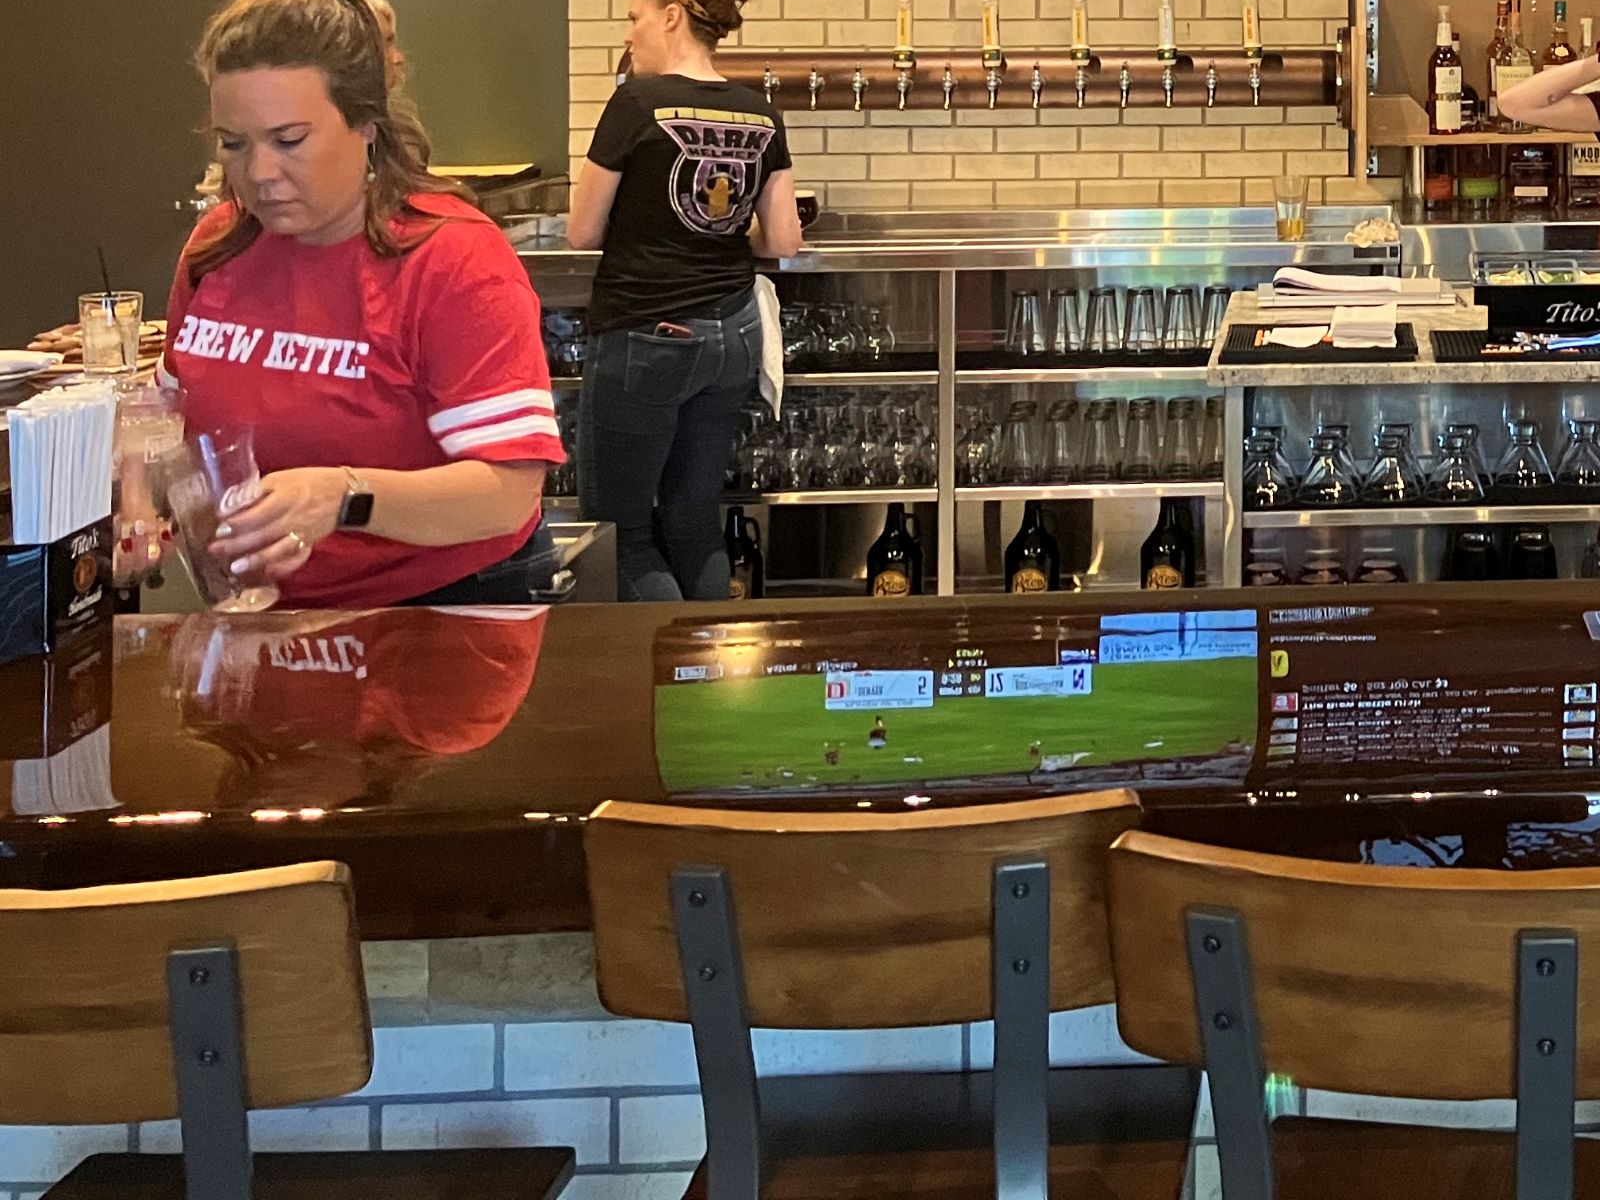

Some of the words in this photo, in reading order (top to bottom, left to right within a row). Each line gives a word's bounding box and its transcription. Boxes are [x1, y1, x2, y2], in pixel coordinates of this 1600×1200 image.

[670, 125, 767, 150] DARK
[1573, 147, 1600, 159] KNOB
[173, 314, 264, 365] BREW
